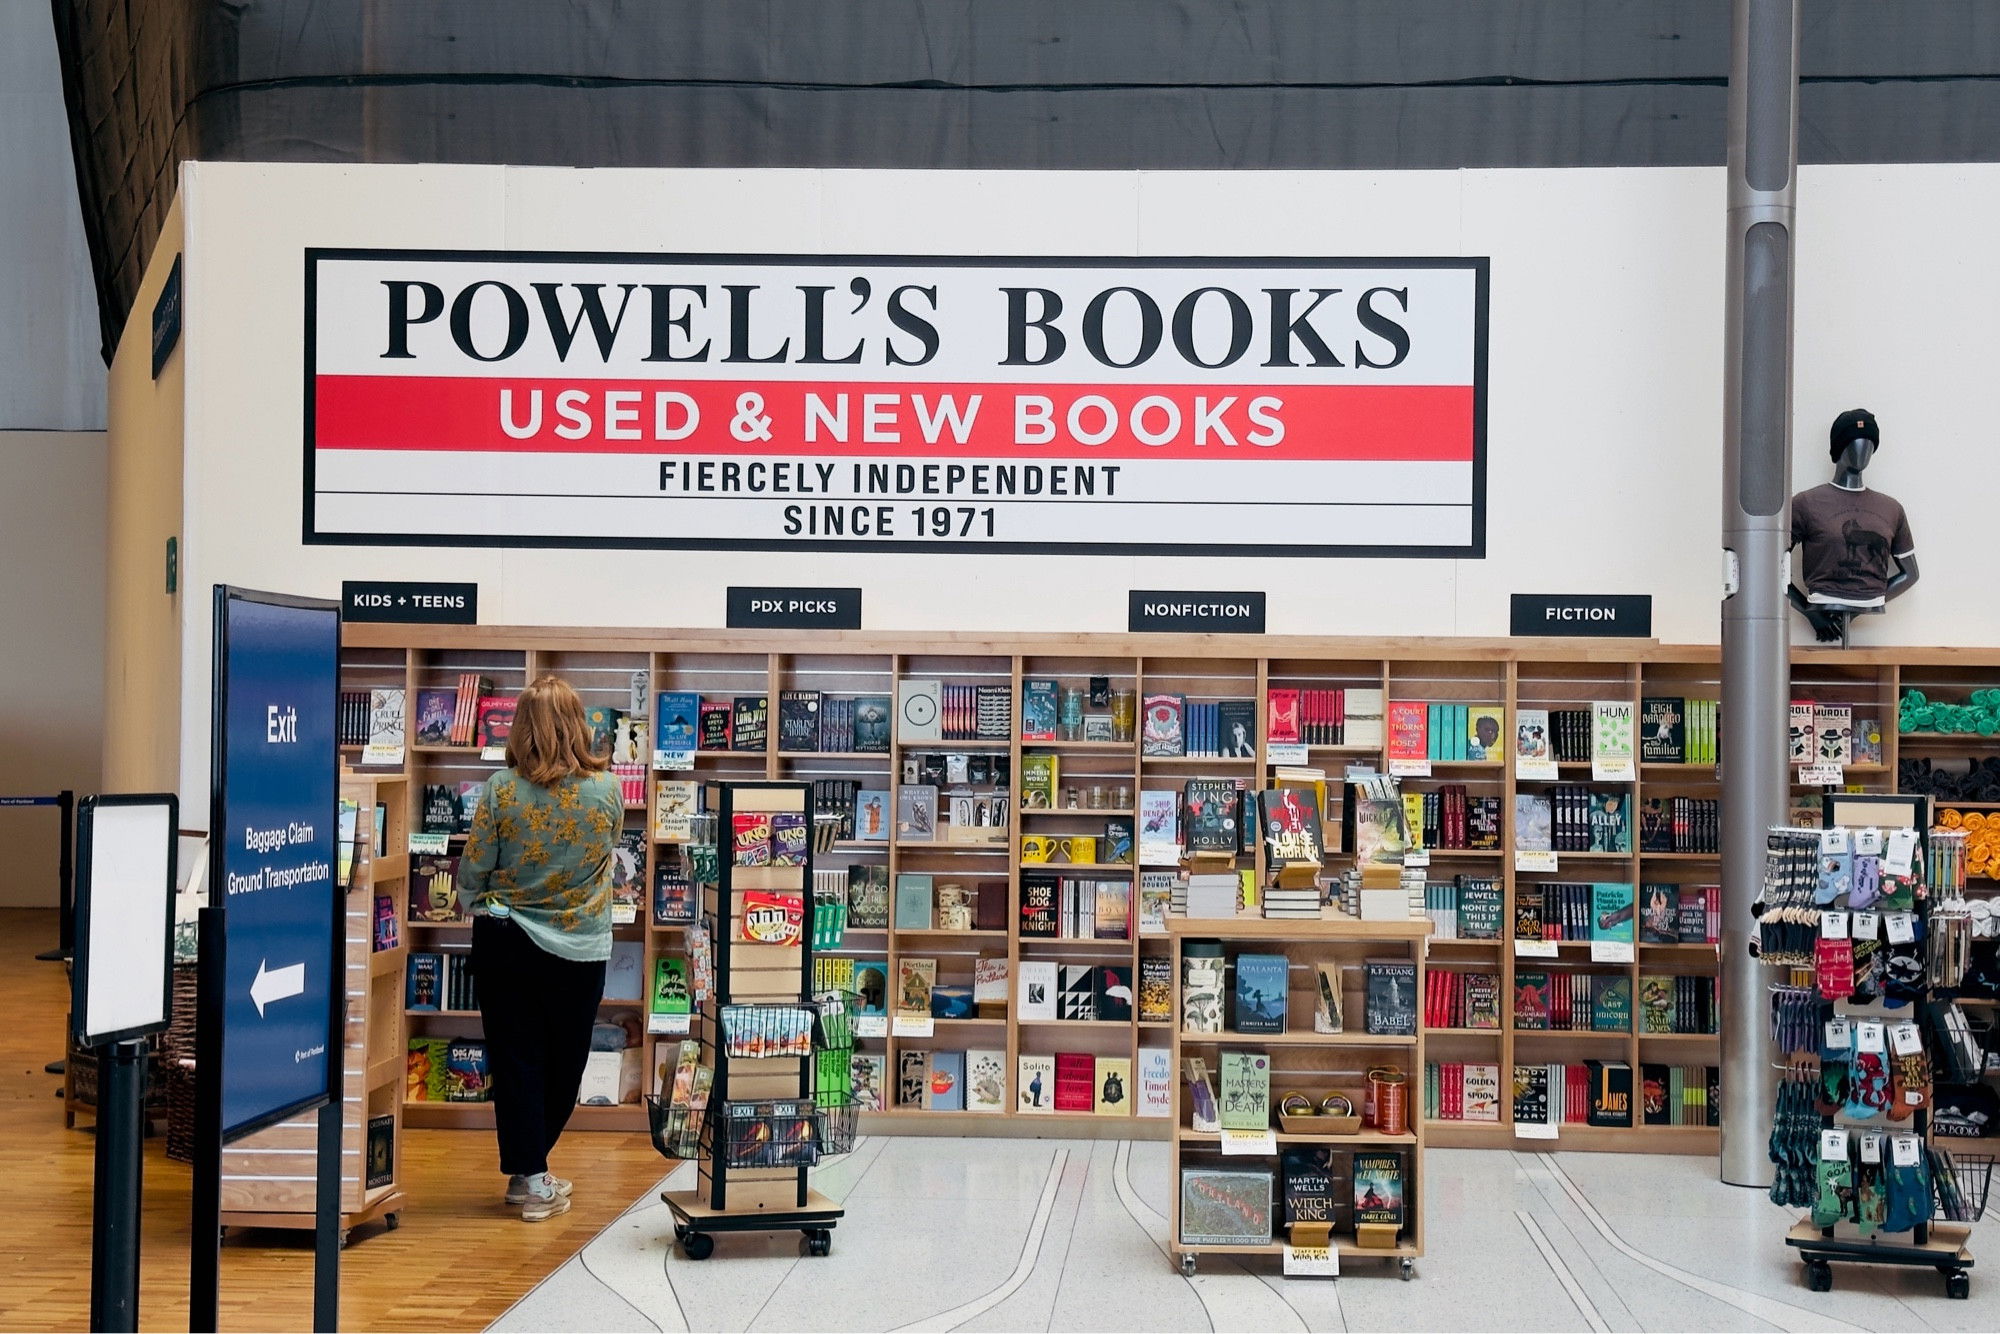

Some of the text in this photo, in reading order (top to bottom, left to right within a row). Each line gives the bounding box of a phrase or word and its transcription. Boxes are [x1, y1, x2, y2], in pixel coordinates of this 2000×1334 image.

[380, 276, 1411, 370] POWELL'S BOOKS
[499, 388, 1286, 447] USED & NEW BOOKS
[659, 461, 1121, 496] FIERCELY INDEPENDENT
[784, 505, 995, 537] SINCE 1971
[354, 594, 465, 609] KIDS + TEENS
[751, 600, 837, 613] PDX PICKS
[1144, 604, 1250, 618] NONFICTION
[1546, 607, 1616, 621] FICTION
[1600, 707, 1629, 718] HUM
[1650, 703, 1672, 714] LEIGH
[1814, 709, 1849, 717] MURDLE
[736, 709, 767, 725] LONG WAY
[1643, 713, 1680, 724] BARDUGO
[267, 705, 298, 744] Exit
[784, 719, 815, 729] STARLING
[750, 730, 766, 740] PLANET
[789, 726, 809, 737] HOUSE
[1192, 792, 1233, 803] KING
[430, 807, 452, 815] WILD
[1143, 810, 1174, 818] BENEATH
[426, 815, 454, 823] ROBOT
[1359, 812, 1389, 824] WICKED
[1592, 813, 1622, 825] ALLEY
[245, 824, 314, 854] Baggage Claim
[736, 825, 769, 848] UNO
[776, 827, 807, 844] UNO
[1274, 832, 1314, 846] LOUISE
[227, 861, 329, 896] Ground Transportation
[866, 885, 888, 893] GOD
[1028, 887, 1052, 896] SHOE
[435, 892, 448, 909] 3
[1029, 897, 1050, 907] DOG
[657, 911, 691, 920] LARSON
[1029, 912, 1049, 921] PHIL
[1679, 917, 1704, 925] Vampire
[1022, 921, 1057, 932] KNIGHT
[1469, 922, 1492, 930] TRUE
[1518, 919, 1540, 928] GOOD
[904, 961, 933, 969] Portland
[977, 959, 996, 972] This
[1386, 968, 1414, 976] KUANG
[976, 972, 1009, 985] Portland
[1374, 1014, 1411, 1026] BABEL
[1595, 1012, 1629, 1021] UNICORN
[452, 1048, 483, 1058] DOG MAN
[1155, 1055, 1167, 1066] On
[1023, 1062, 1051, 1071] Solito
[1063, 1072, 1089, 1081] about
[1466, 1078, 1496, 1086] GOLDEN
[1066, 1083, 1084, 1092] love
[1226, 1079, 1266, 1090] MASTERS
[1595, 1067, 1628, 1111] JAMES
[1147, 1095, 1170, 1108] Snyde
[1467, 1092, 1494, 1100] SPOON
[733, 1107, 754, 1116] EXIT
[1225, 1100, 1265, 1115] DEATH
[369, 1117, 393, 1130] ORDINARY
[1949, 1126, 1980, 1137] BOOKS
[1359, 1159, 1396, 1170] VAMPIRES
[1374, 1169, 1399, 1181] NORTE
[1827, 1168, 1851, 1177] GOAT
[1289, 1177, 1330, 1185] MARTHA
[1294, 1184, 1325, 1192] WELLS
[1193, 1178, 1265, 1225] PORTLAND
[1289, 1198, 1333, 1209] WITCH
[1296, 1209, 1327, 1221] KING
[1292, 1253, 1329, 1262] Witch King
